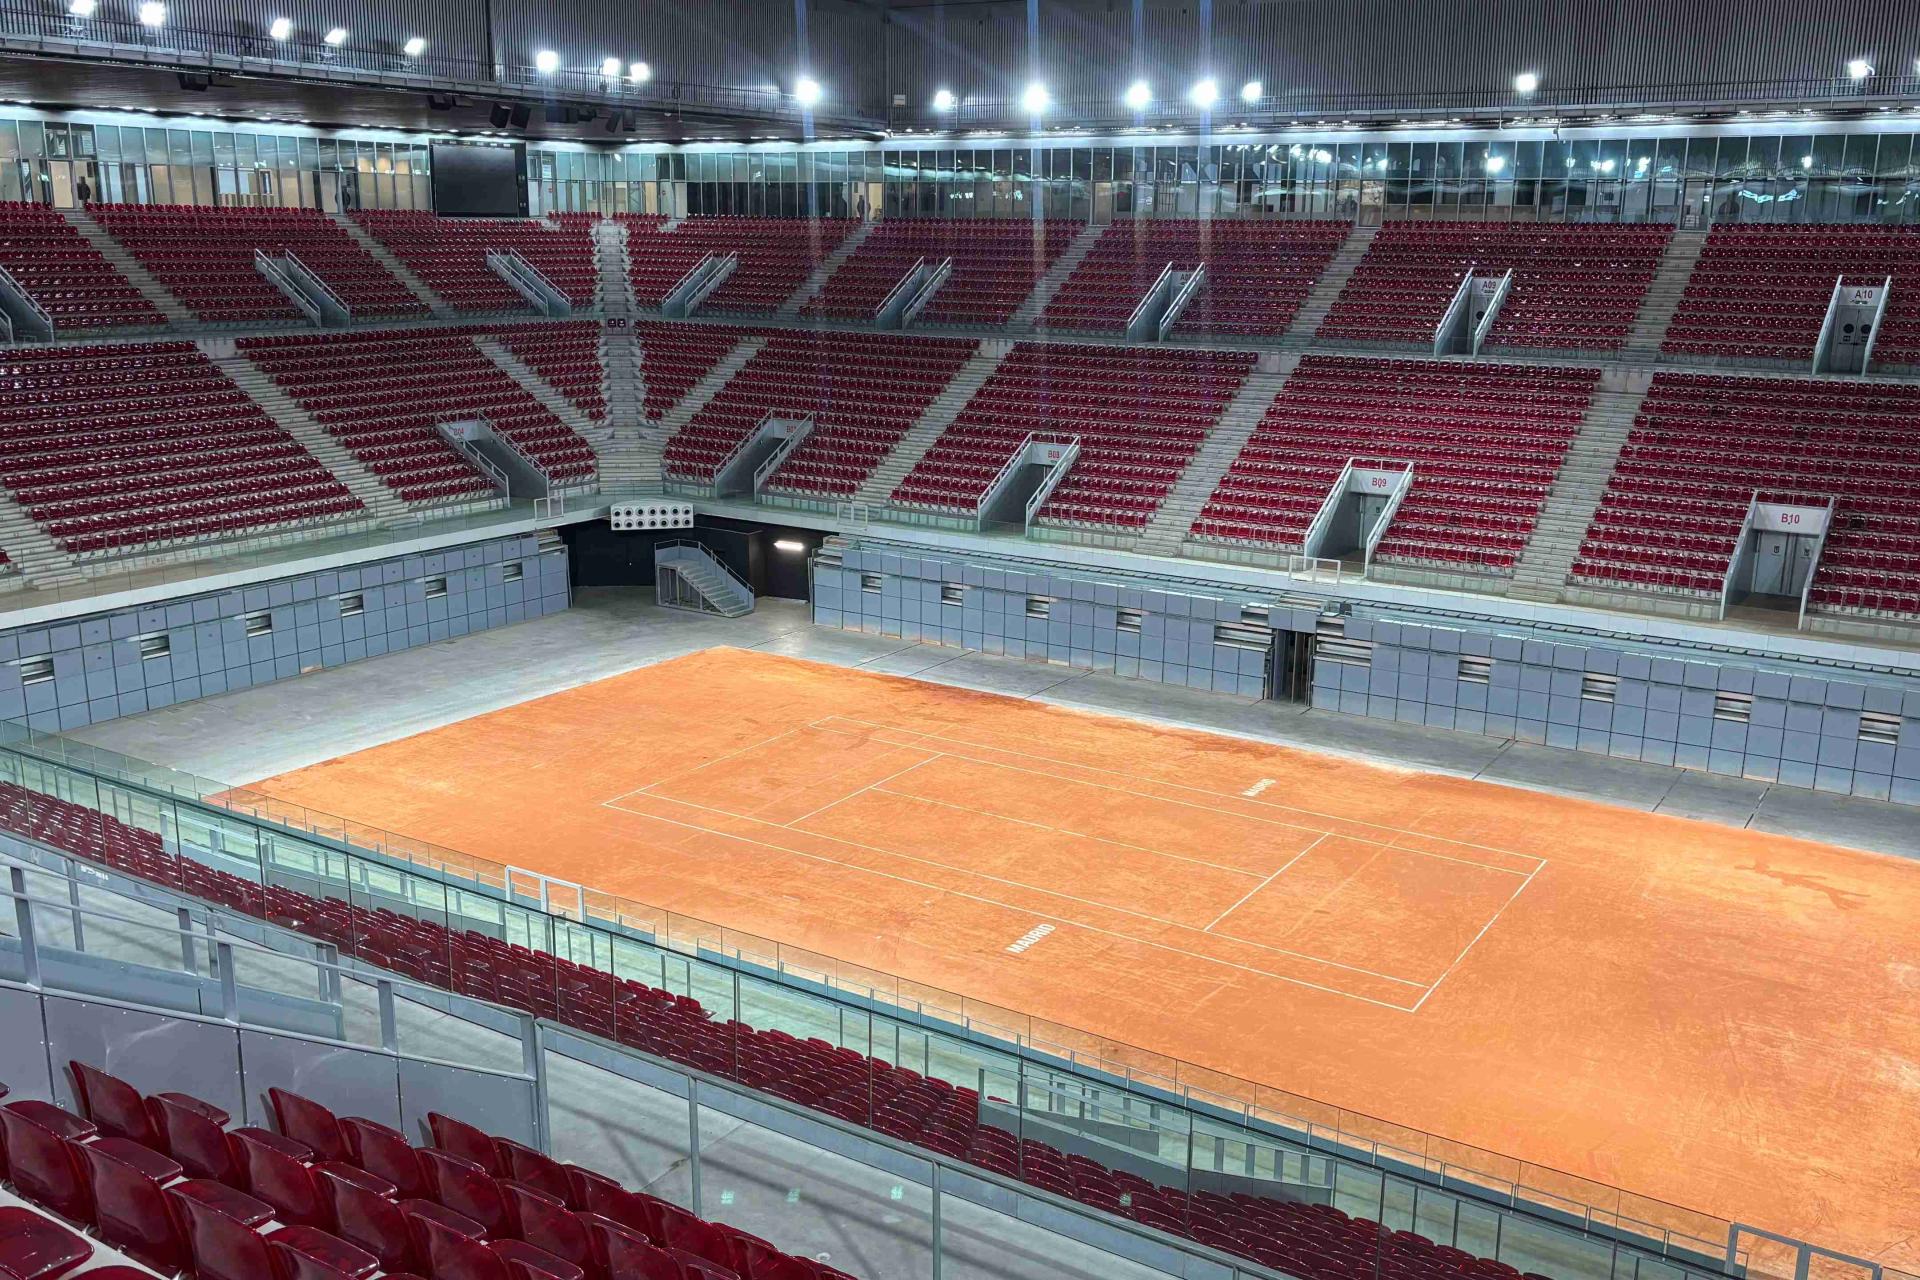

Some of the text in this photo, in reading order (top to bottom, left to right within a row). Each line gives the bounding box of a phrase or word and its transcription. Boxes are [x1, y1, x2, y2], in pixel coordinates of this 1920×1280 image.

[1482, 281, 1496, 289] A09
[1855, 290, 1873, 298] A10
[1371, 477, 1387, 488] B09
[1781, 513, 1800, 524] B10
[1004, 923, 1056, 954] MADRID
